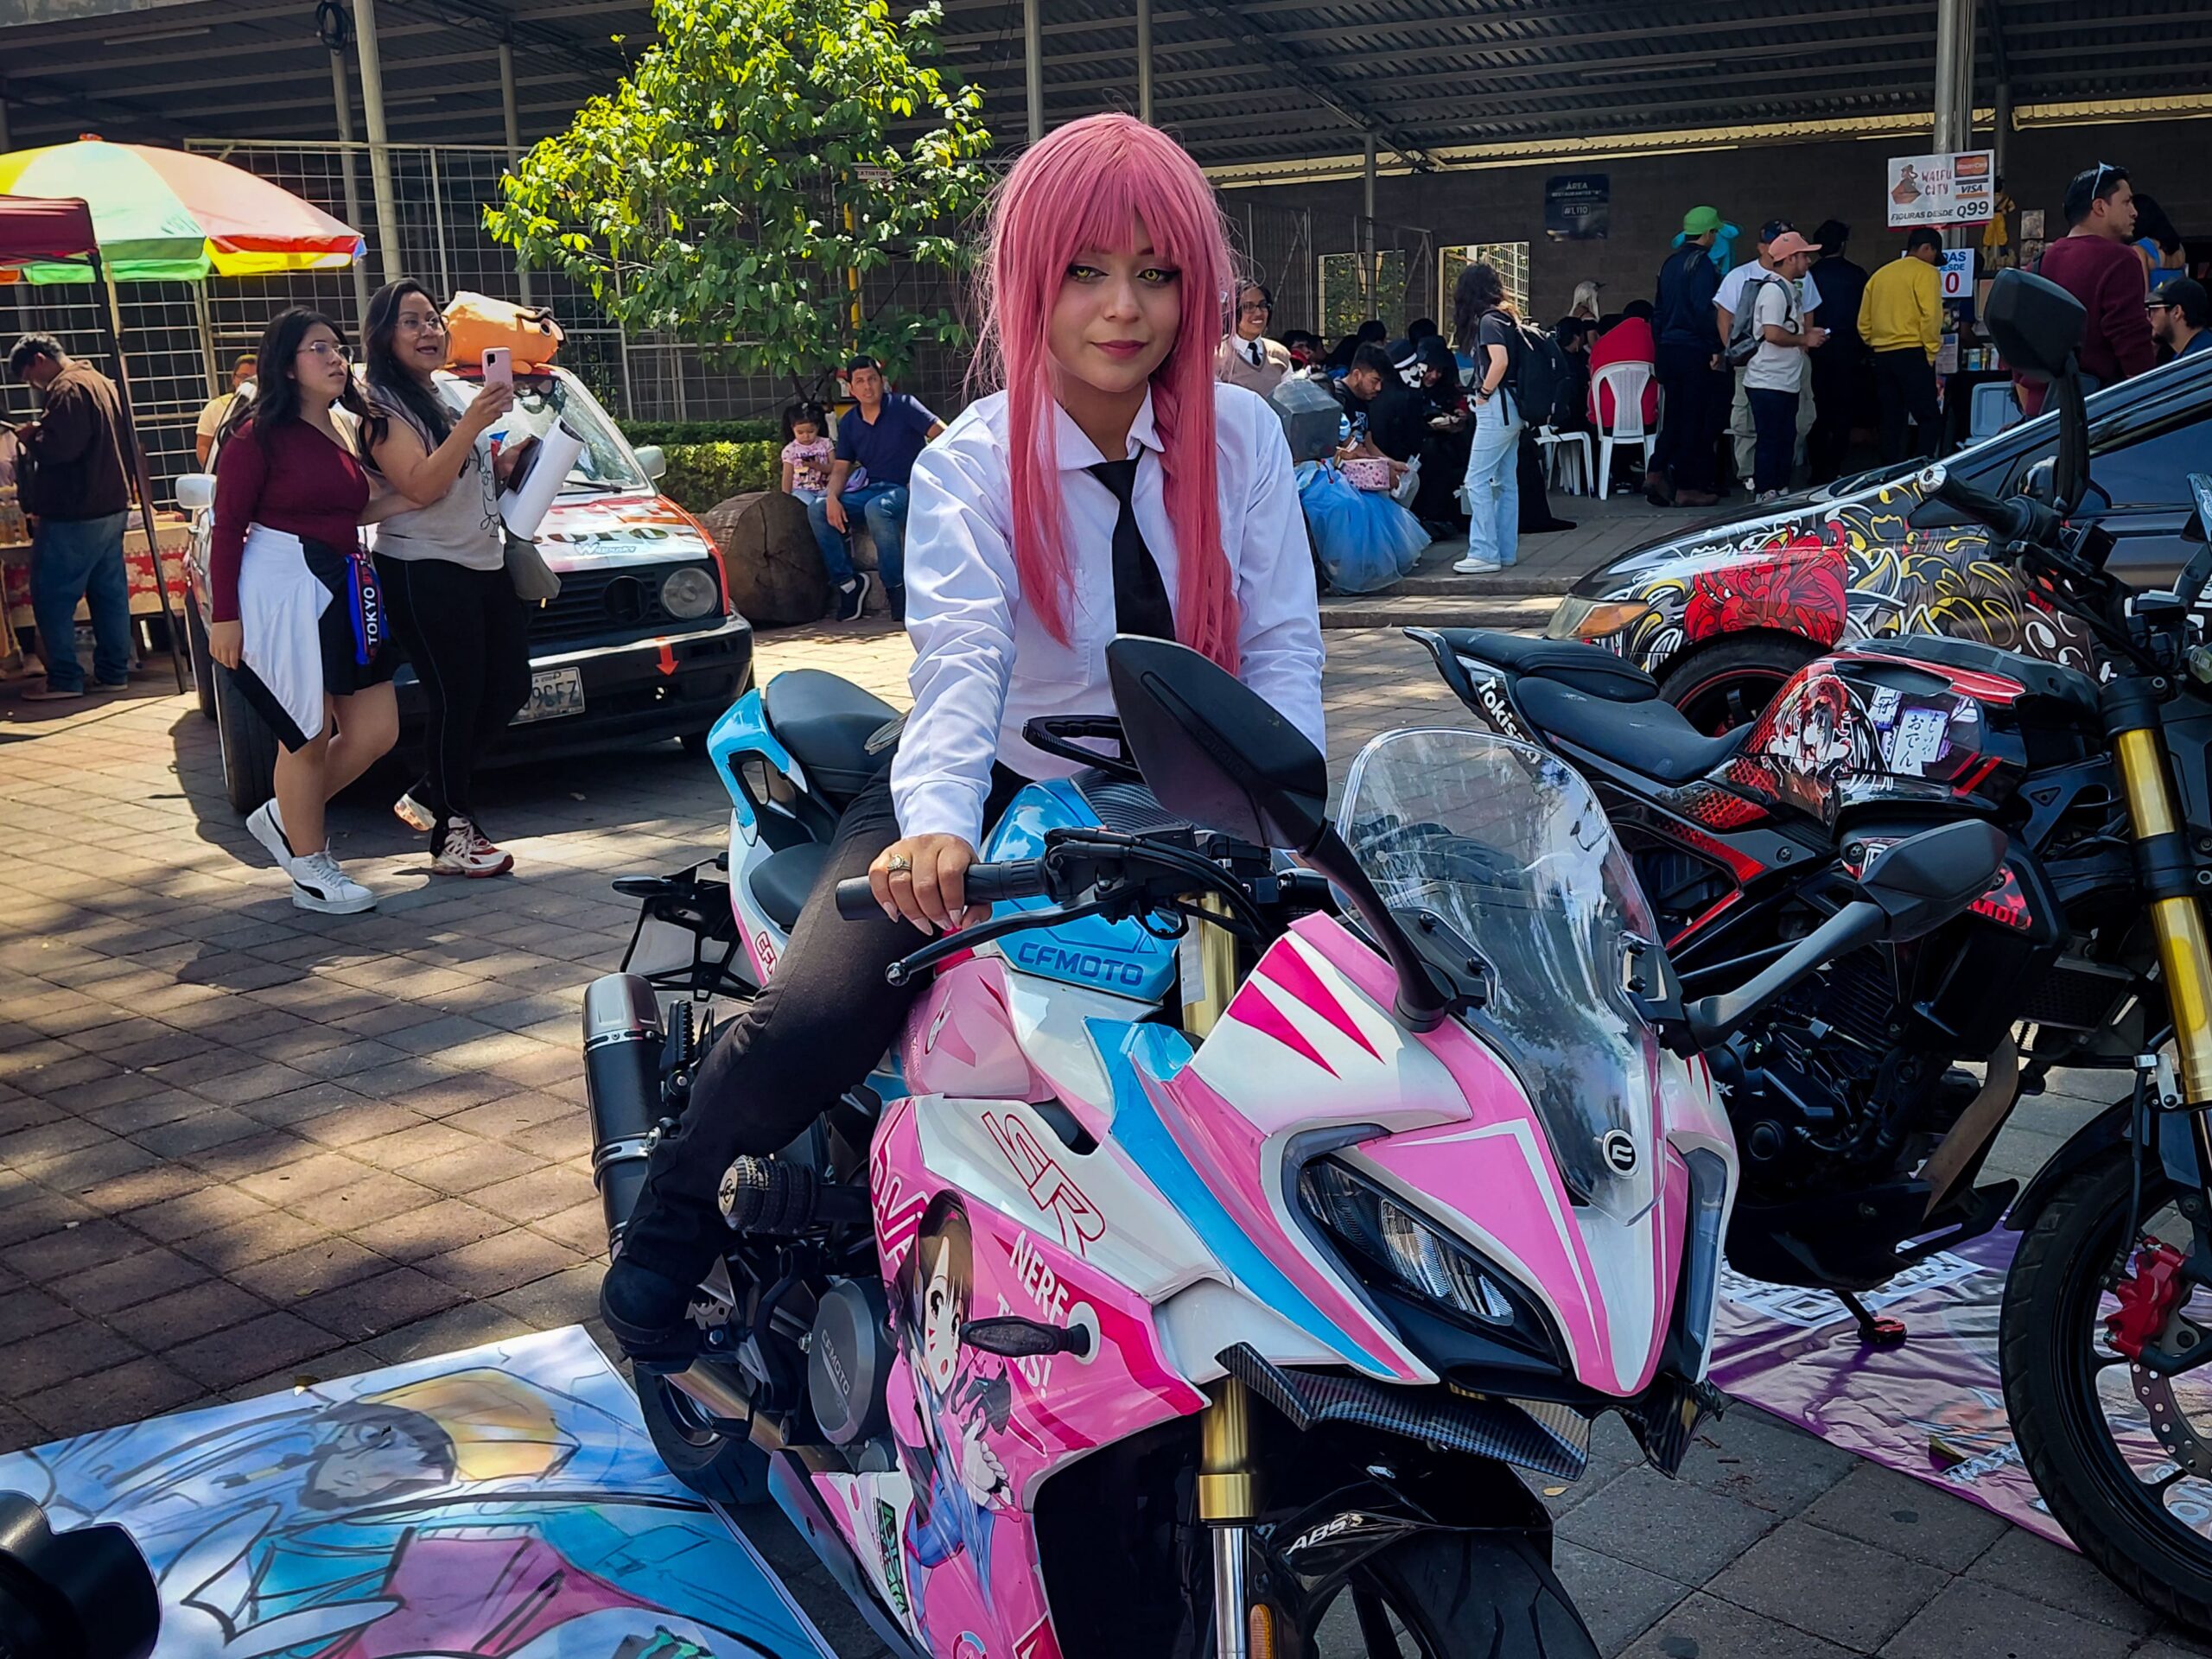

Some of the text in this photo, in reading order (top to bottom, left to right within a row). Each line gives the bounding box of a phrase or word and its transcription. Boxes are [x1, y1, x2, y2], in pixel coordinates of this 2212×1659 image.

[1922, 169, 1952, 181] WAIFU
[1925, 184, 1948, 195] CITY
[1961, 184, 1983, 194] VISA
[1891, 200, 1989, 220] FIGURAS DESDE Q99
[363, 587, 378, 645] TOKYO
[1018, 942, 1144, 987] CFMOTO
[1008, 1230, 1069, 1324] NERF
[821, 1329, 850, 1395] CFMOTO
[1285, 1512, 1349, 1556] ABS
